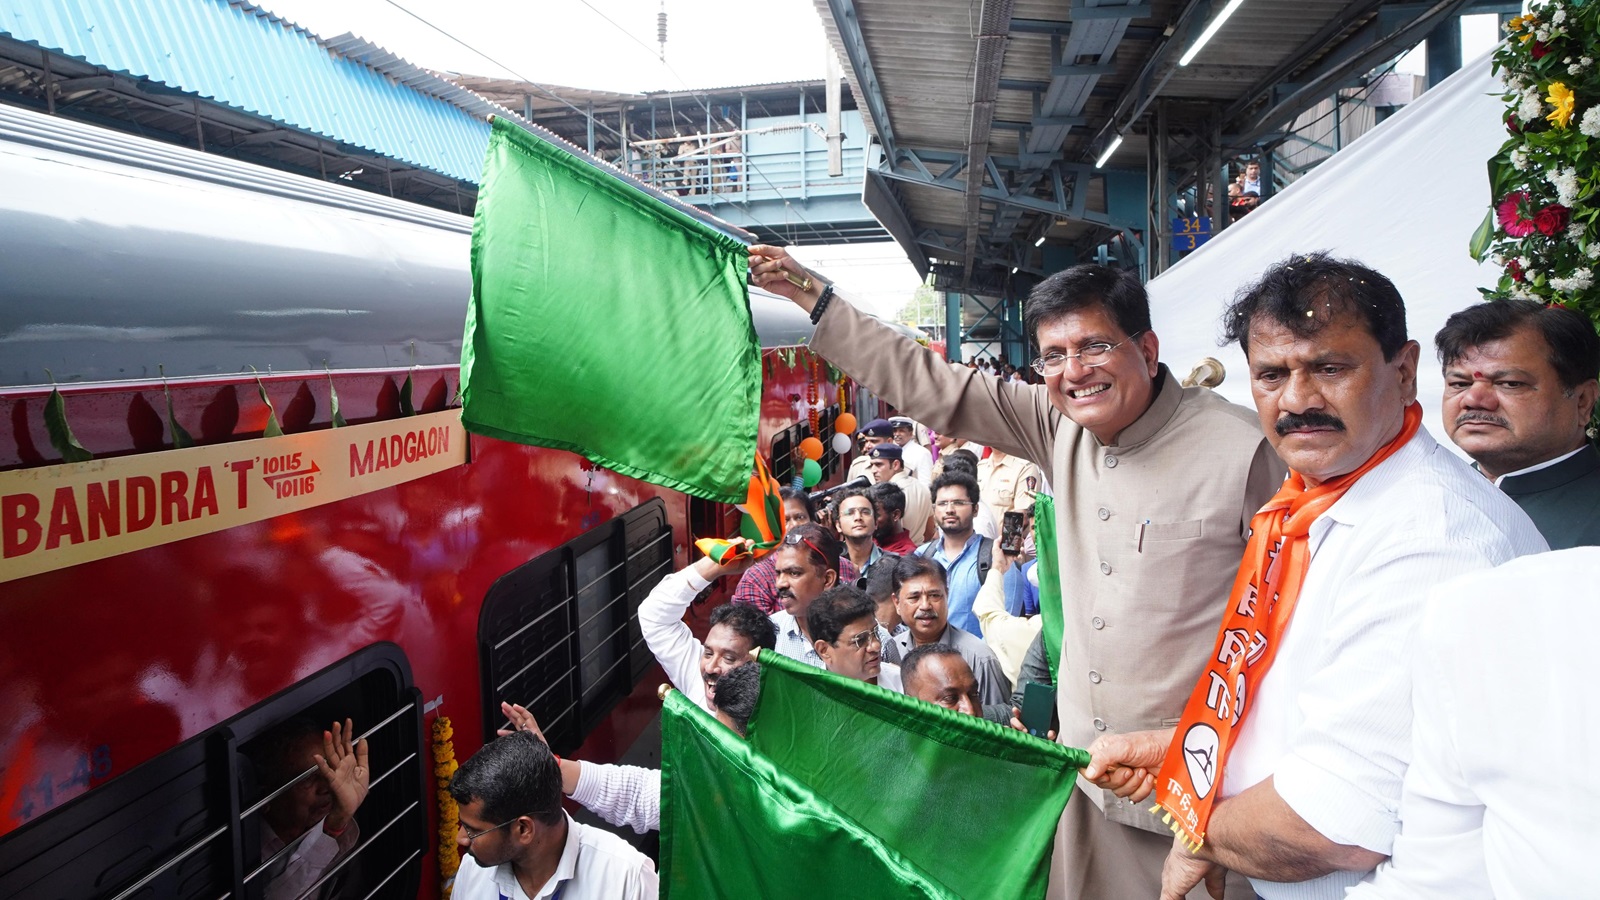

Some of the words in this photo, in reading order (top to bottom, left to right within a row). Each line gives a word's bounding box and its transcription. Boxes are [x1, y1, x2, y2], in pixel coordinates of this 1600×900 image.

[1182, 218, 1201, 233] 34
[1187, 235, 1196, 249] 3
[263, 452, 302, 474] 10115
[349, 426, 450, 478] MADGAON
[276, 476, 315, 499] 10116
[1, 466, 219, 559] BANDRA
[9, 744, 112, 819] 41-48
